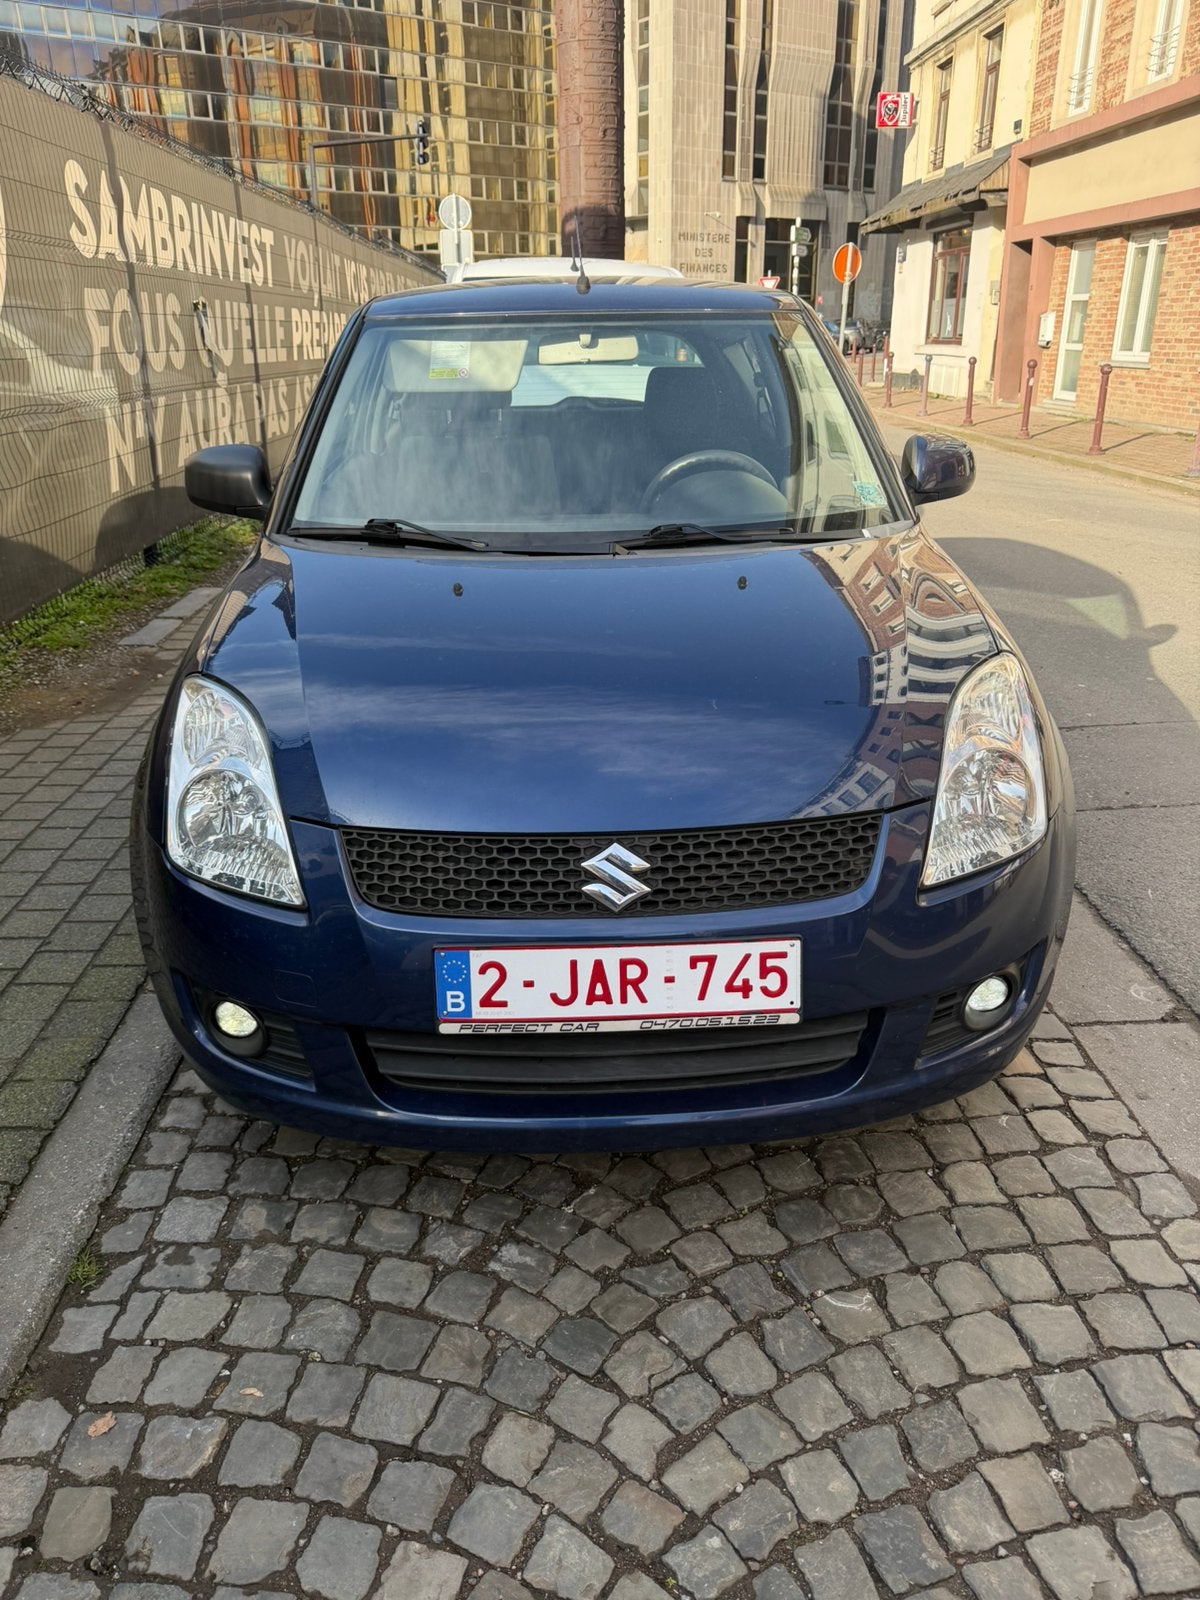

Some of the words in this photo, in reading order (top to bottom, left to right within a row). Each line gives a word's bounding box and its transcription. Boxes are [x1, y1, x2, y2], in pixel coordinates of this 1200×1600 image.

[901, 94, 909, 125] Jupiler
[64, 159, 274, 288] SAMBRINVEST
[283, 235, 341, 300] VOULAIT
[344, 257, 371, 305] VOUS
[694, 247, 714, 258] DES
[679, 262, 728, 273] FINANCES
[193, 297, 288, 378] QU'ELLE
[178, 384, 250, 467] AURA
[253, 378, 289, 443] PAS
[445, 990, 466, 1012] B
[458, 1023, 553, 1033] PERFECT
[559, 1022, 600, 1032] CAR
[640, 1015, 781, 1030] 0470.05.15.23
